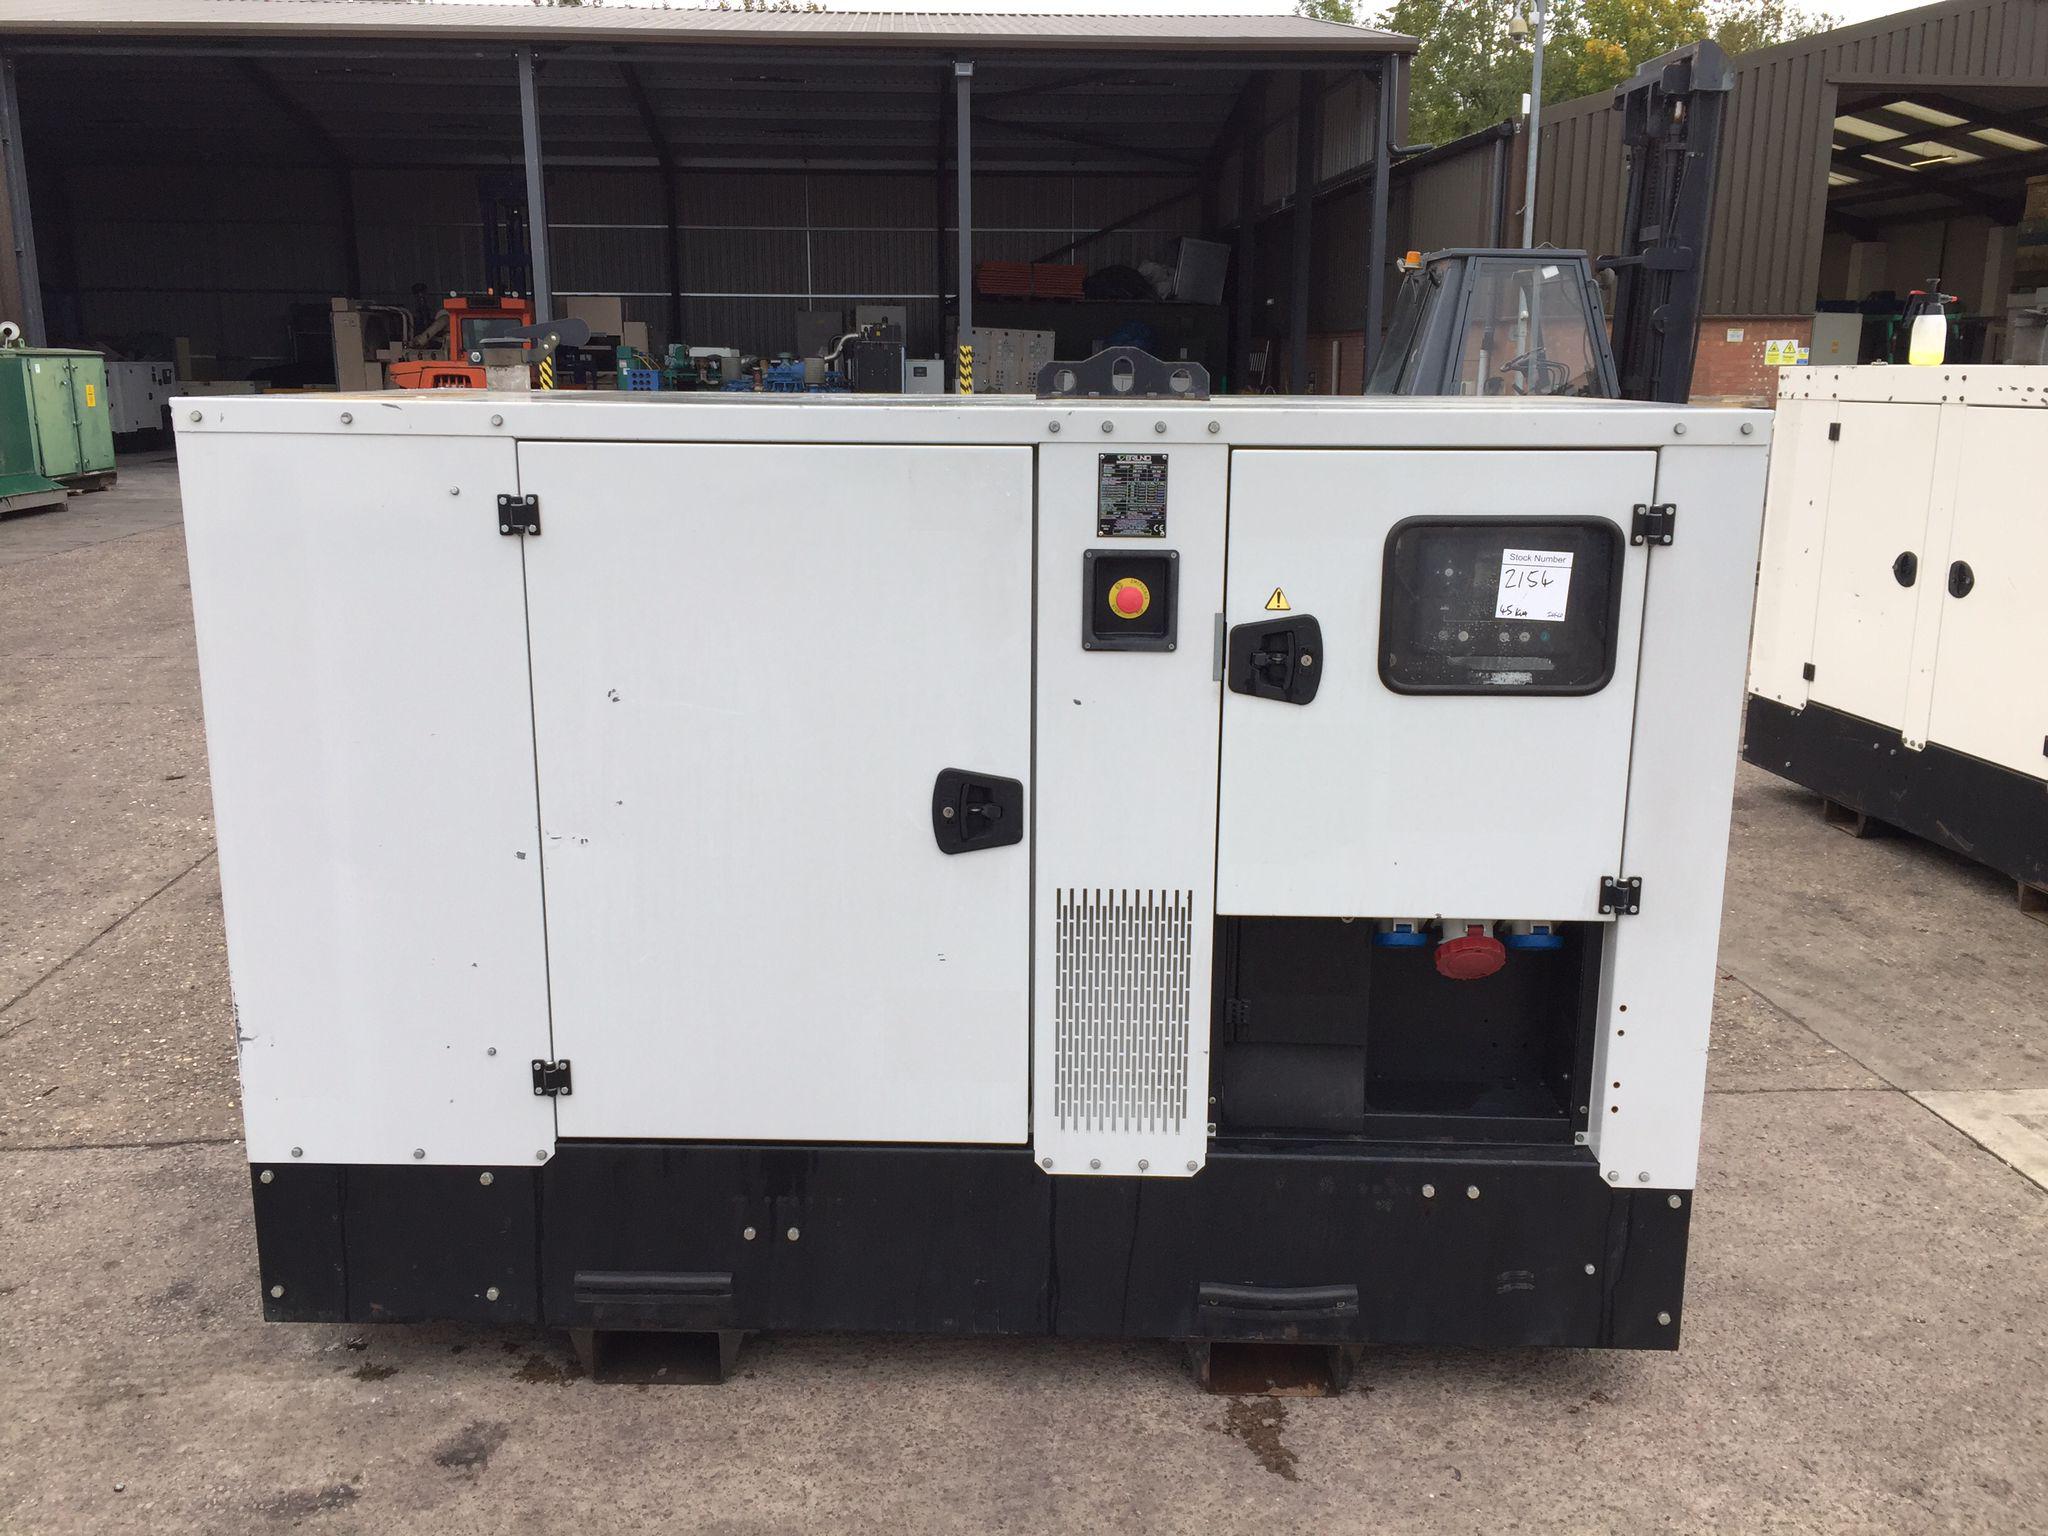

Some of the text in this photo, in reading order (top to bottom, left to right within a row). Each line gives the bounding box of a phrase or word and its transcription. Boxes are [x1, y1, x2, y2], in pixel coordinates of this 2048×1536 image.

[1509, 553, 1567, 563] Stock Number
[1504, 568, 1554, 589] 2154
[1499, 604, 1513, 616] 45
